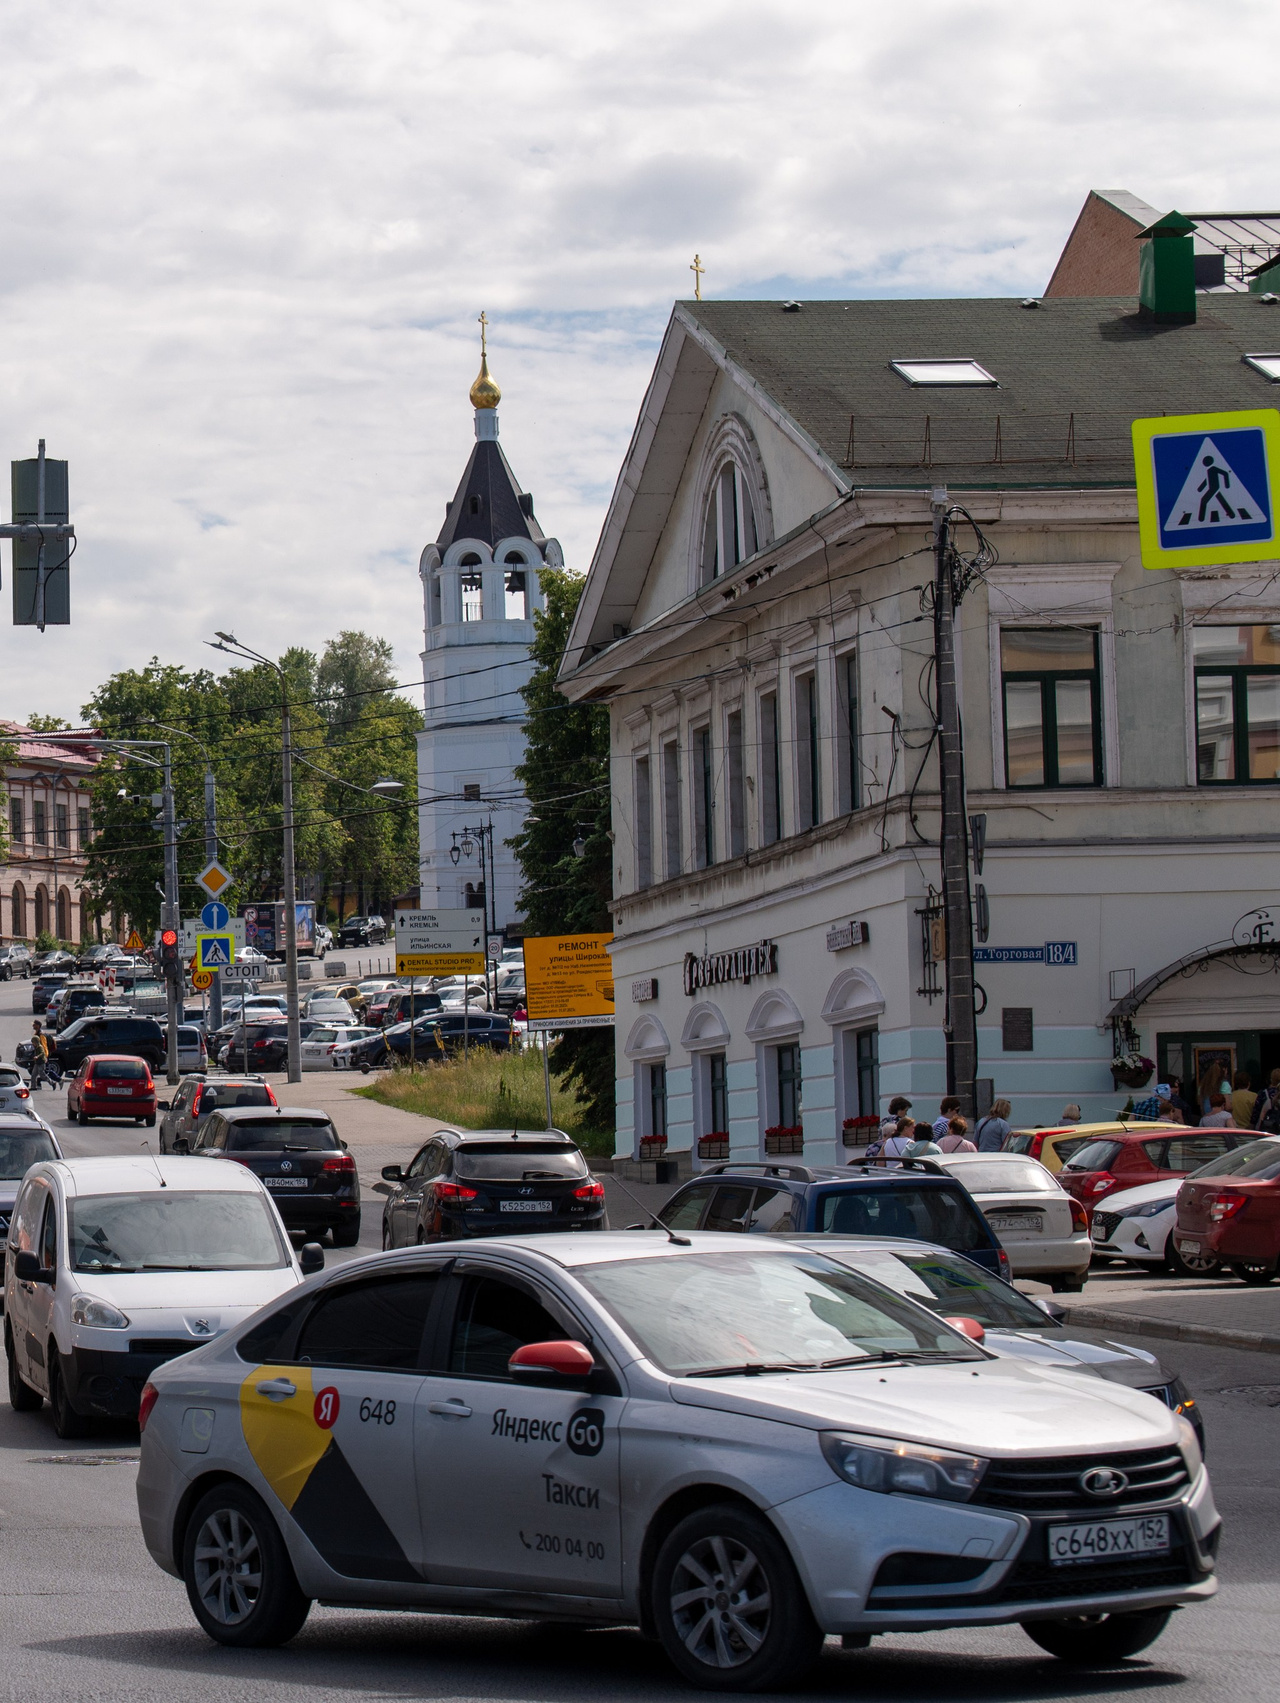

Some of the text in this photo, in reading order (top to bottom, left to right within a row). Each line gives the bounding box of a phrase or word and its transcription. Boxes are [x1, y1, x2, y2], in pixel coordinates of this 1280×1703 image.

[558, 941, 599, 951] РЕМОНТ
[1048, 944, 1075, 963] 18/4
[549, 955, 574, 964] улицы
[196, 975, 209, 983] 40
[225, 966, 260, 977] СТОП
[502, 1202, 536, 1211] К525ОВ
[319, 1393, 334, 1421] Я
[359, 1397, 397, 1426] 648
[491, 1408, 599, 1448] Яндекс Go
[541, 1473, 600, 1509] Такси
[535, 1533, 605, 1560] 200 04 00
[1056, 1519, 1164, 1556] С648ХХ 152
